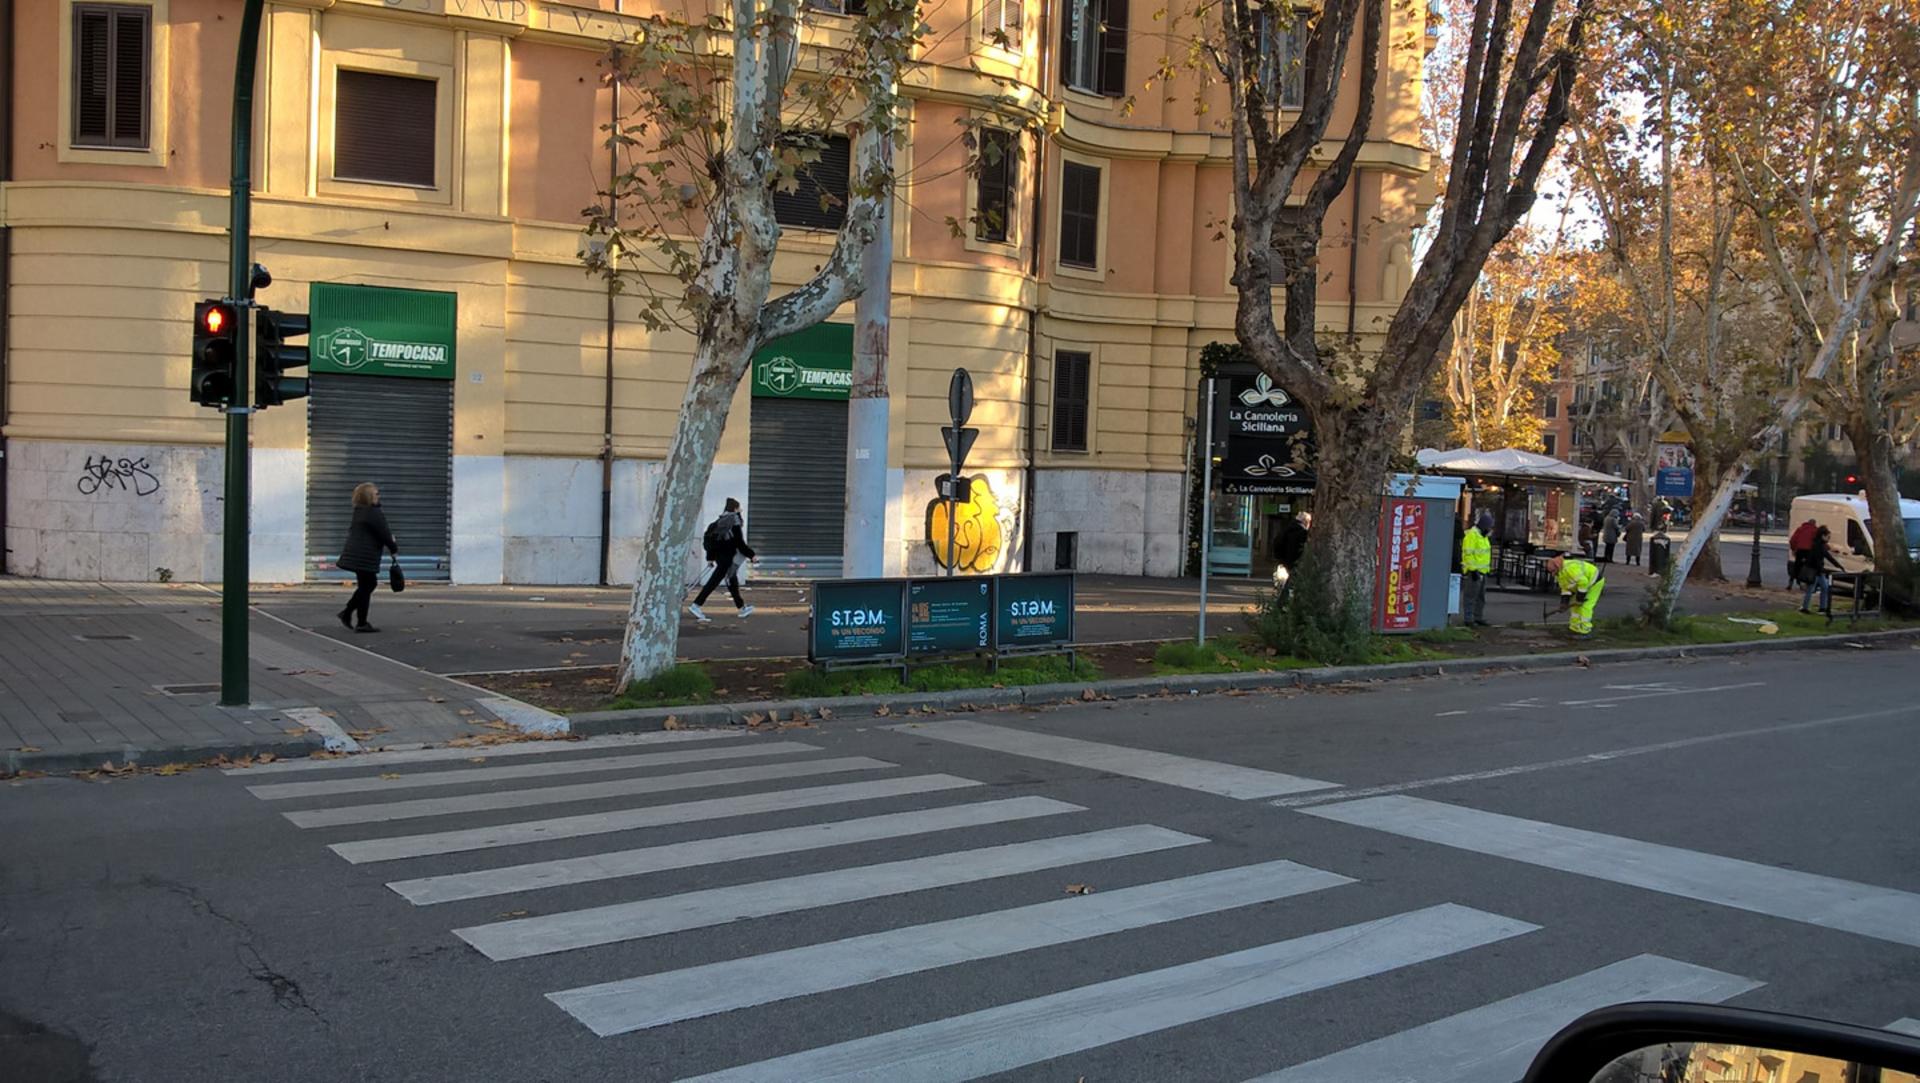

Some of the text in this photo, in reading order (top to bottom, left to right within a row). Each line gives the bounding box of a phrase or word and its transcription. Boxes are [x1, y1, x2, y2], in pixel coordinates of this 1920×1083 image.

[372, 342, 444, 362] TEMPOCASA
[801, 370, 853, 386] TEMPOCAS
[1230, 410, 1298, 422] La Cannoleria
[1241, 421, 1285, 433] Siciliana
[1239, 484, 1248, 492] La
[1249, 484, 1284, 493] Cannoleria
[1387, 504, 1404, 615] FOTOTESSERA
[979, 612, 988, 647] ROMA
